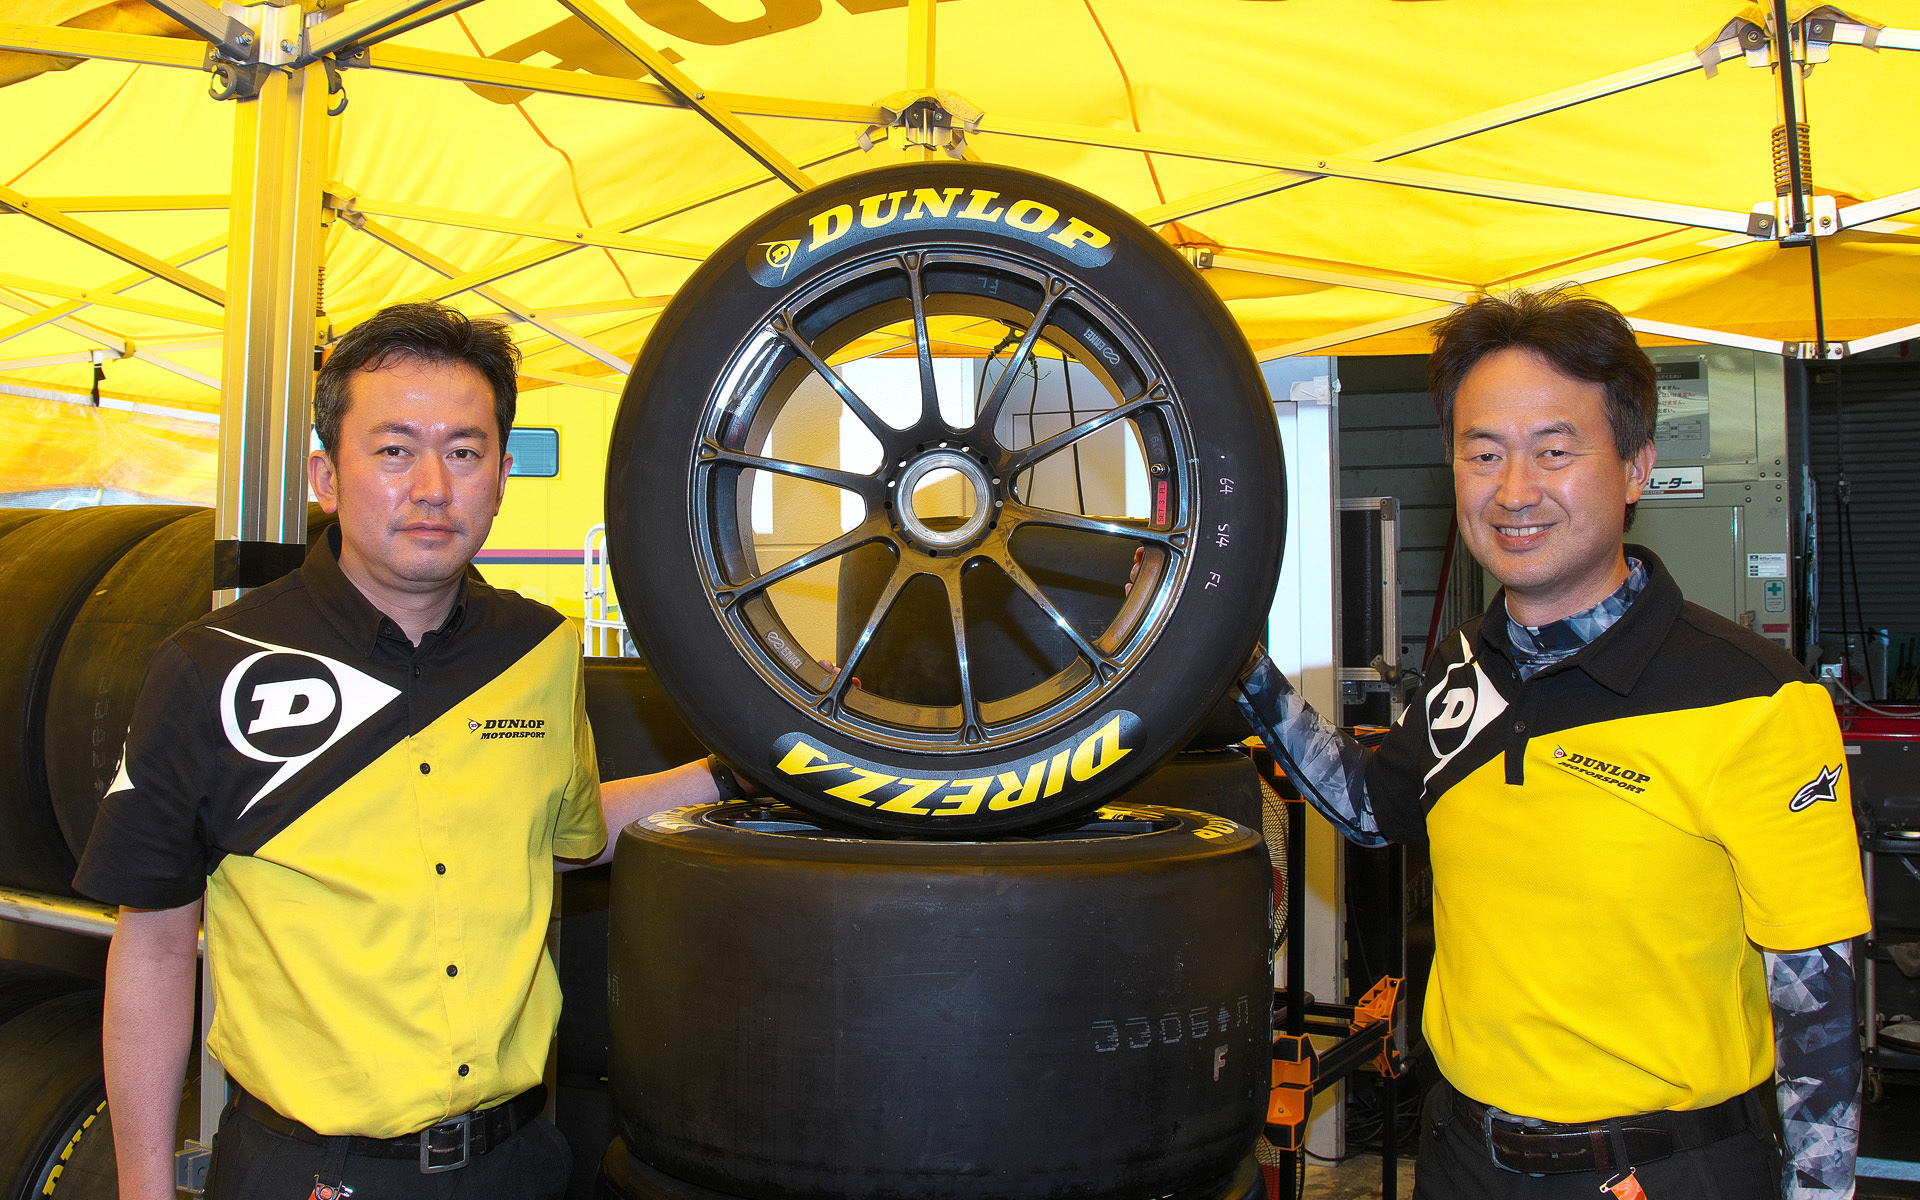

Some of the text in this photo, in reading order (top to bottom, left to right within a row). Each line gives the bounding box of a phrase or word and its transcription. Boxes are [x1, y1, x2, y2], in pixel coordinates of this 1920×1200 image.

[808, 187, 1111, 253] DUNLOP
[977, 277, 999, 295] FL
[1646, 477, 1692, 489] レーター
[1204, 571, 1221, 591] FL
[780, 646, 803, 669] ENKEI
[247, 677, 337, 735] D
[1430, 686, 1476, 731] D
[480, 731, 546, 740] MOTORSPORT
[483, 719, 545, 730] DUNLOP
[776, 714, 1133, 817] DIREZZA
[1557, 761, 1646, 795] MOTORSPORT
[1567, 753, 1651, 784] DUNLOP
[1213, 1043, 1229, 1082] F
